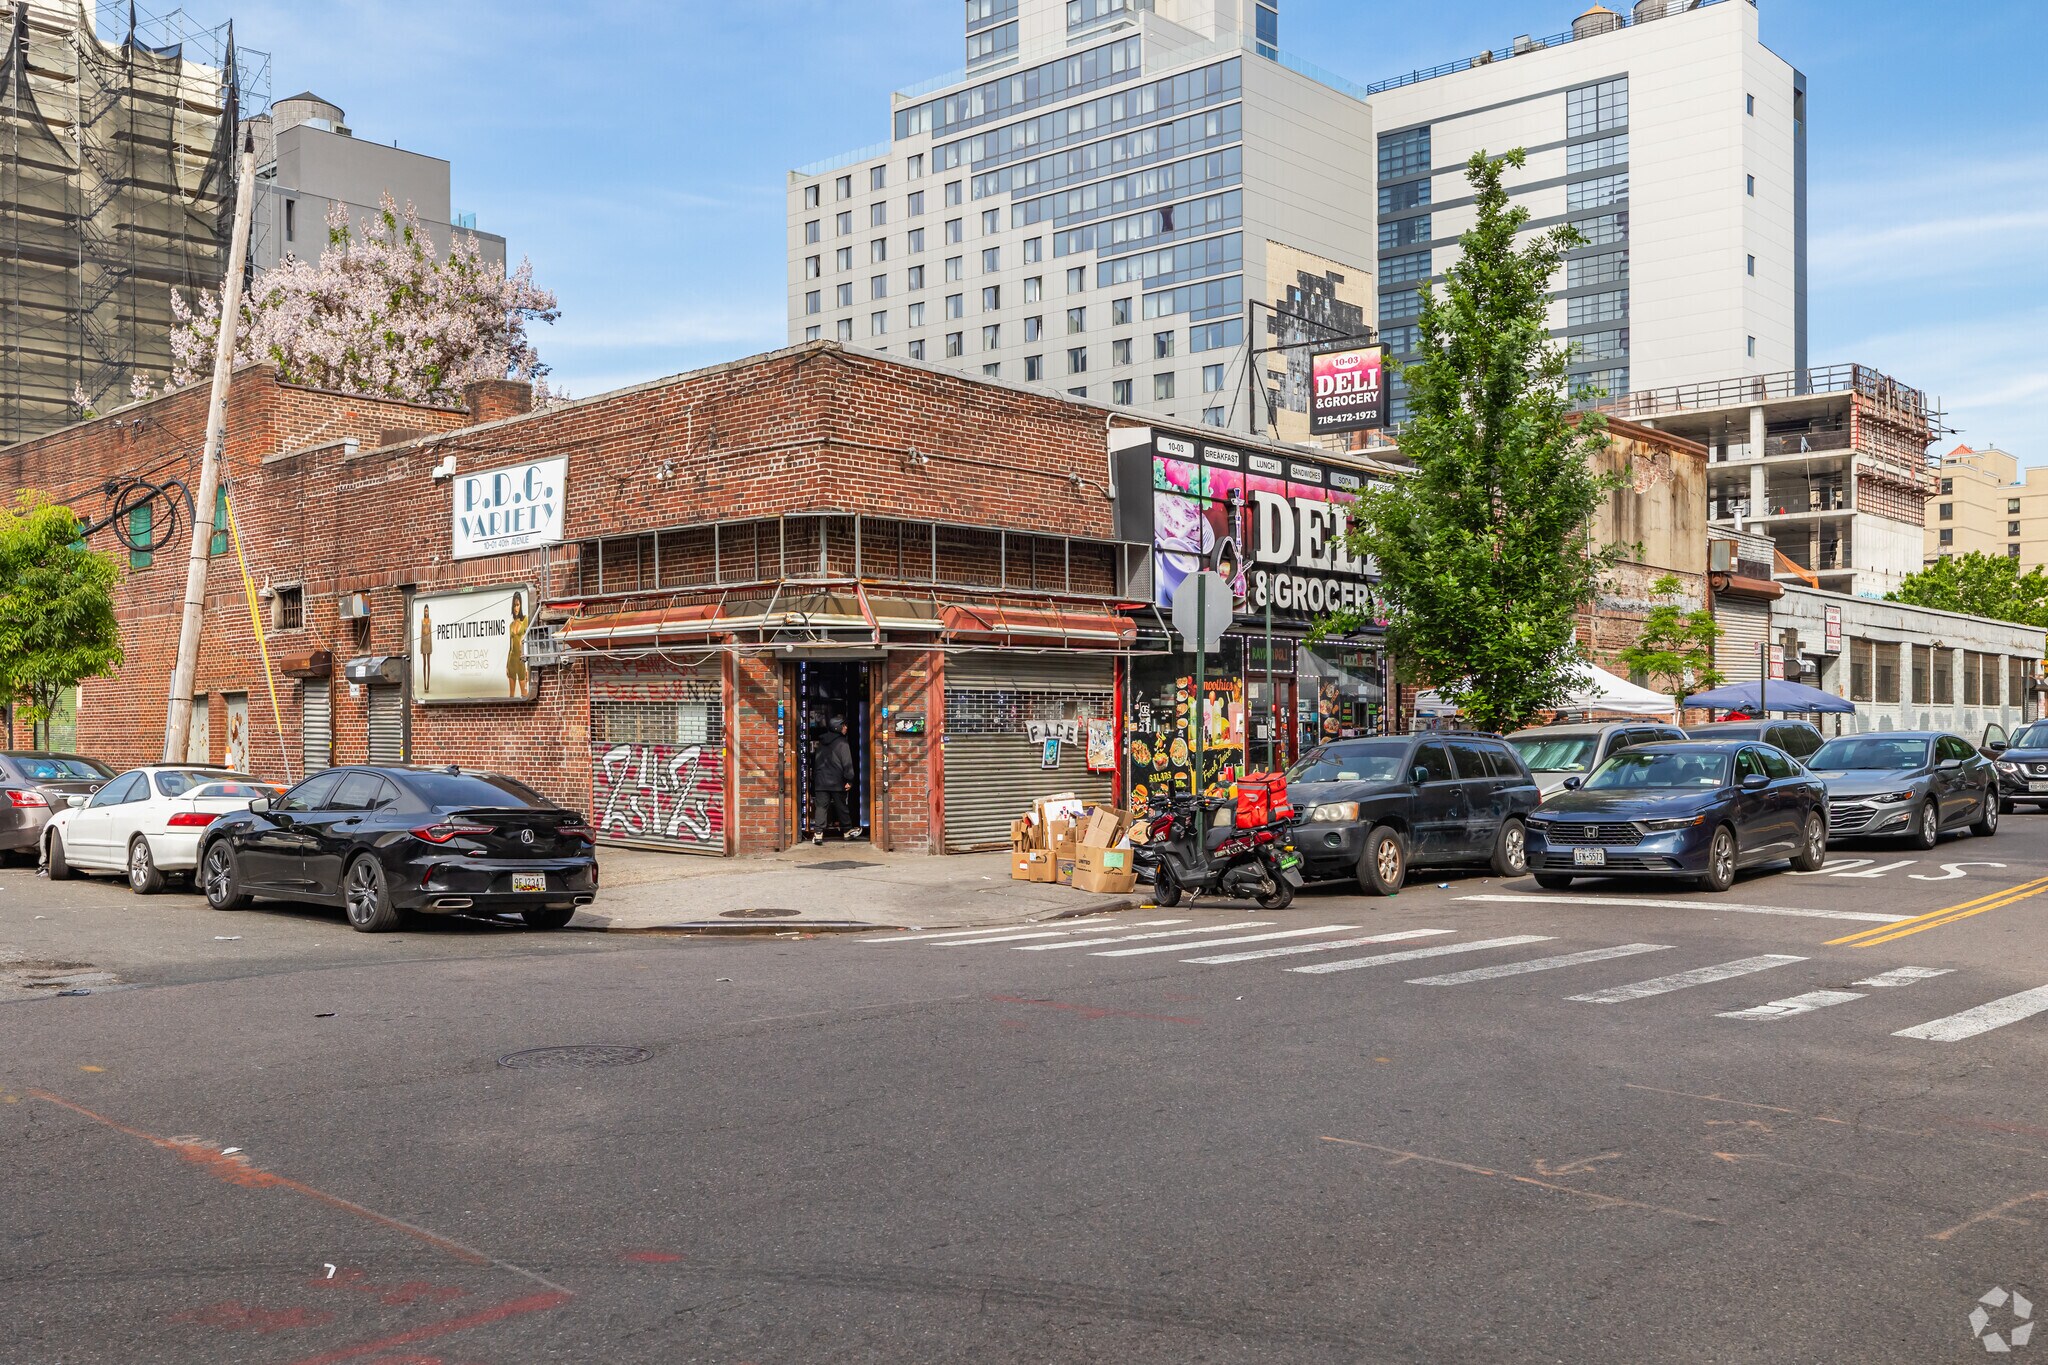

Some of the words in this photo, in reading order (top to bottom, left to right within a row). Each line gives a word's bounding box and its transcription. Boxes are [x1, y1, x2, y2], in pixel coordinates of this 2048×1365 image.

[1335, 356, 1359, 366] 10-03
[1316, 368, 1379, 397] DELI
[1316, 391, 1379, 409] &GROCERY
[1317, 410, 1377, 425] 718-472-1973
[1168, 442, 1185, 453] 10-03
[1205, 449, 1239, 464] BREAKFAST
[1256, 460, 1275, 471] LUNCH
[1292, 466, 1321, 480] SANDWICHES
[1338, 476, 1352, 486] SODA
[464, 466, 553, 512] P.D.G.
[460, 502, 557, 540] VARIETY
[510, 535, 529, 545] AVENUE
[437, 619, 506, 640] PRETTYLITTLETHING
[452, 649, 473, 660] NEXT
[473, 649, 489, 659] DAY
[452, 660, 489, 670] SHIPPING
[1030, 723, 1075, 742] FACE
[1148, 771, 1172, 783] SALADS
[1202, 759, 1218, 783] Fresh
